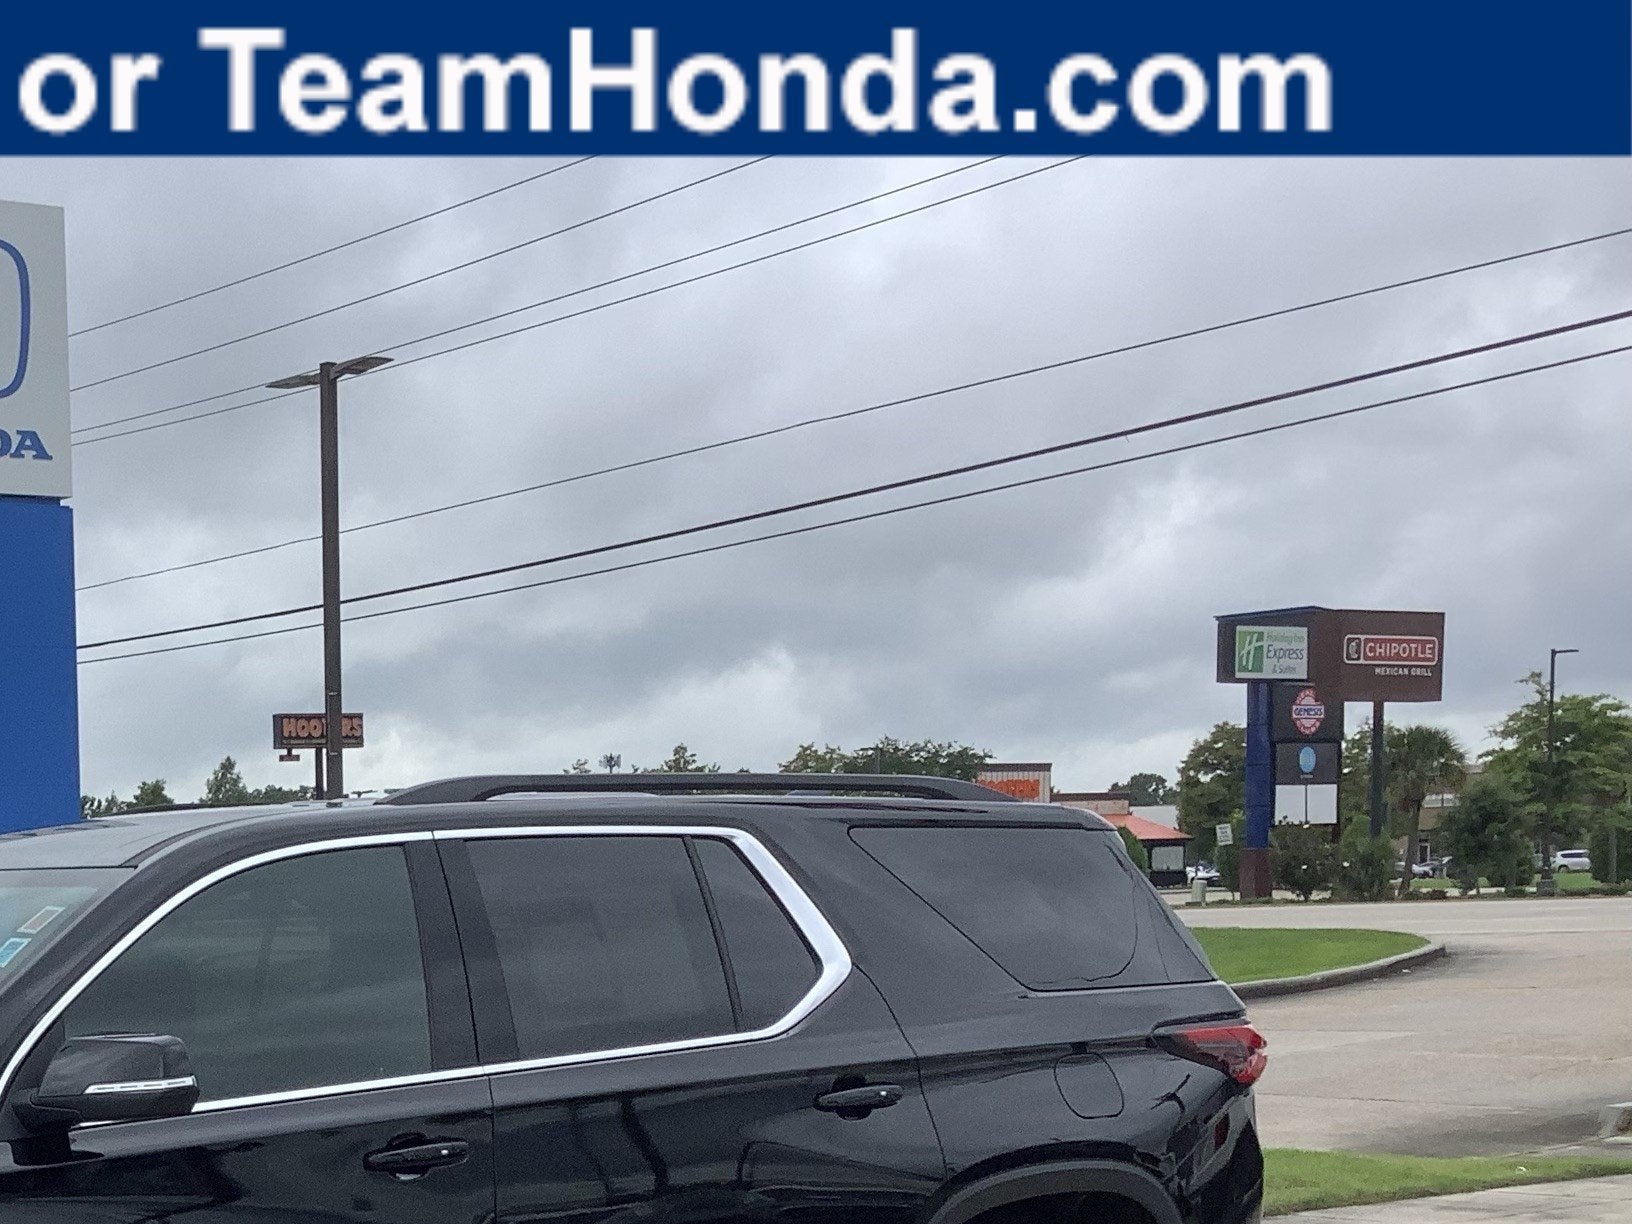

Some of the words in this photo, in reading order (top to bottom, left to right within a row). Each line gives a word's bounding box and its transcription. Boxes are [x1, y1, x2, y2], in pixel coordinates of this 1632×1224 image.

[1266, 644, 1305, 663] Express
[1366, 643, 1433, 657] CHIPOTLE
[1374, 667, 1409, 676] MEXICAN
[1411, 668, 1432, 677] GRILL
[282, 717, 363, 738] HOORS
